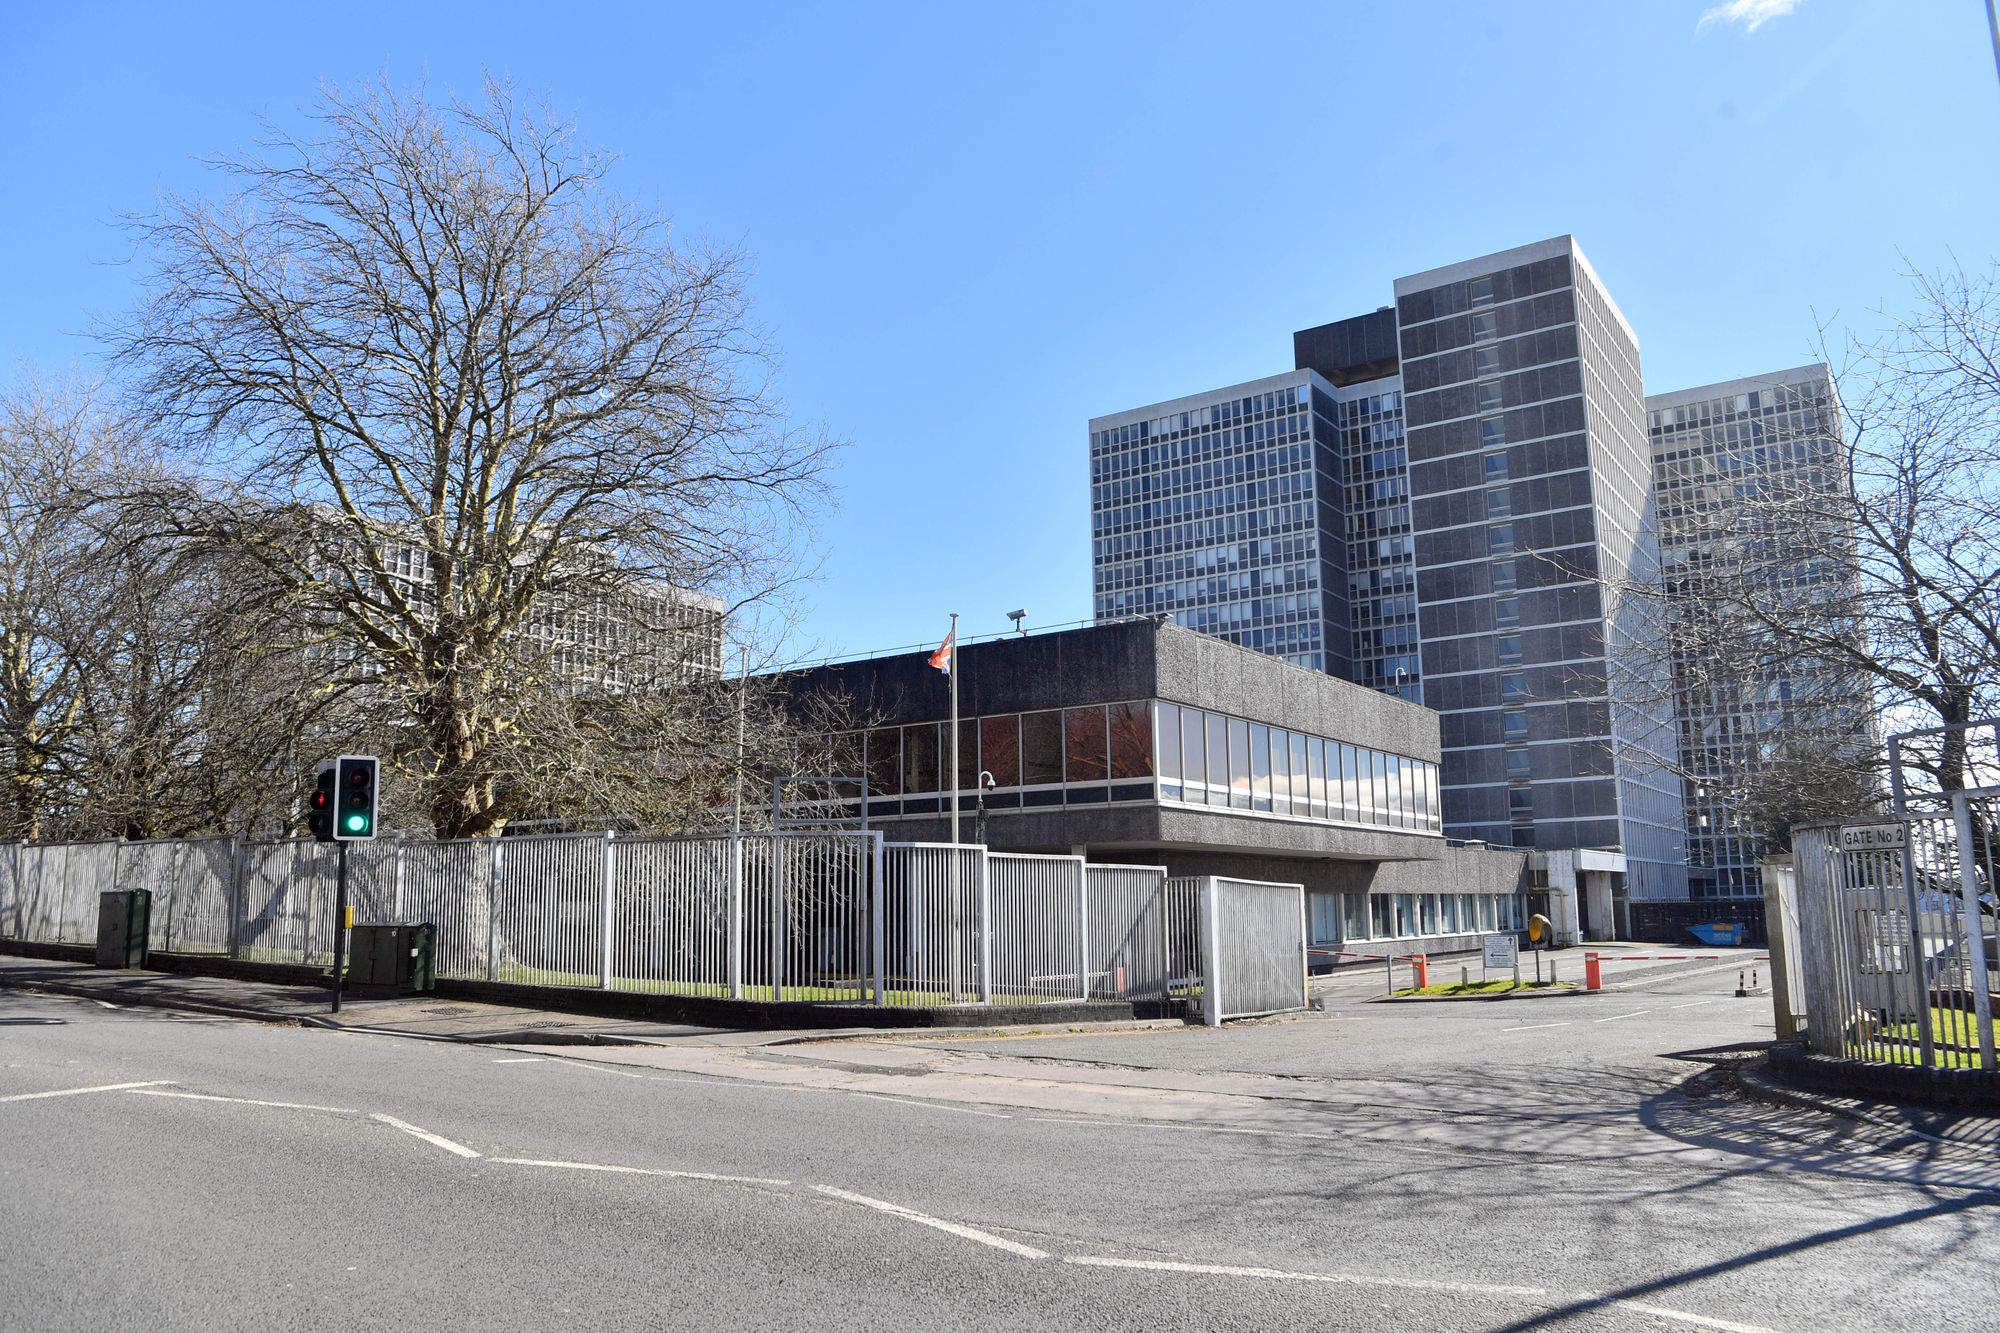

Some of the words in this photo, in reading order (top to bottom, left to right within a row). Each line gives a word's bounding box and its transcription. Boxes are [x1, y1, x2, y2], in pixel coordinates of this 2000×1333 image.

[1845, 831, 1872, 845] GATE
[1877, 830, 1892, 843] No
[1896, 829, 1904, 841] 2
